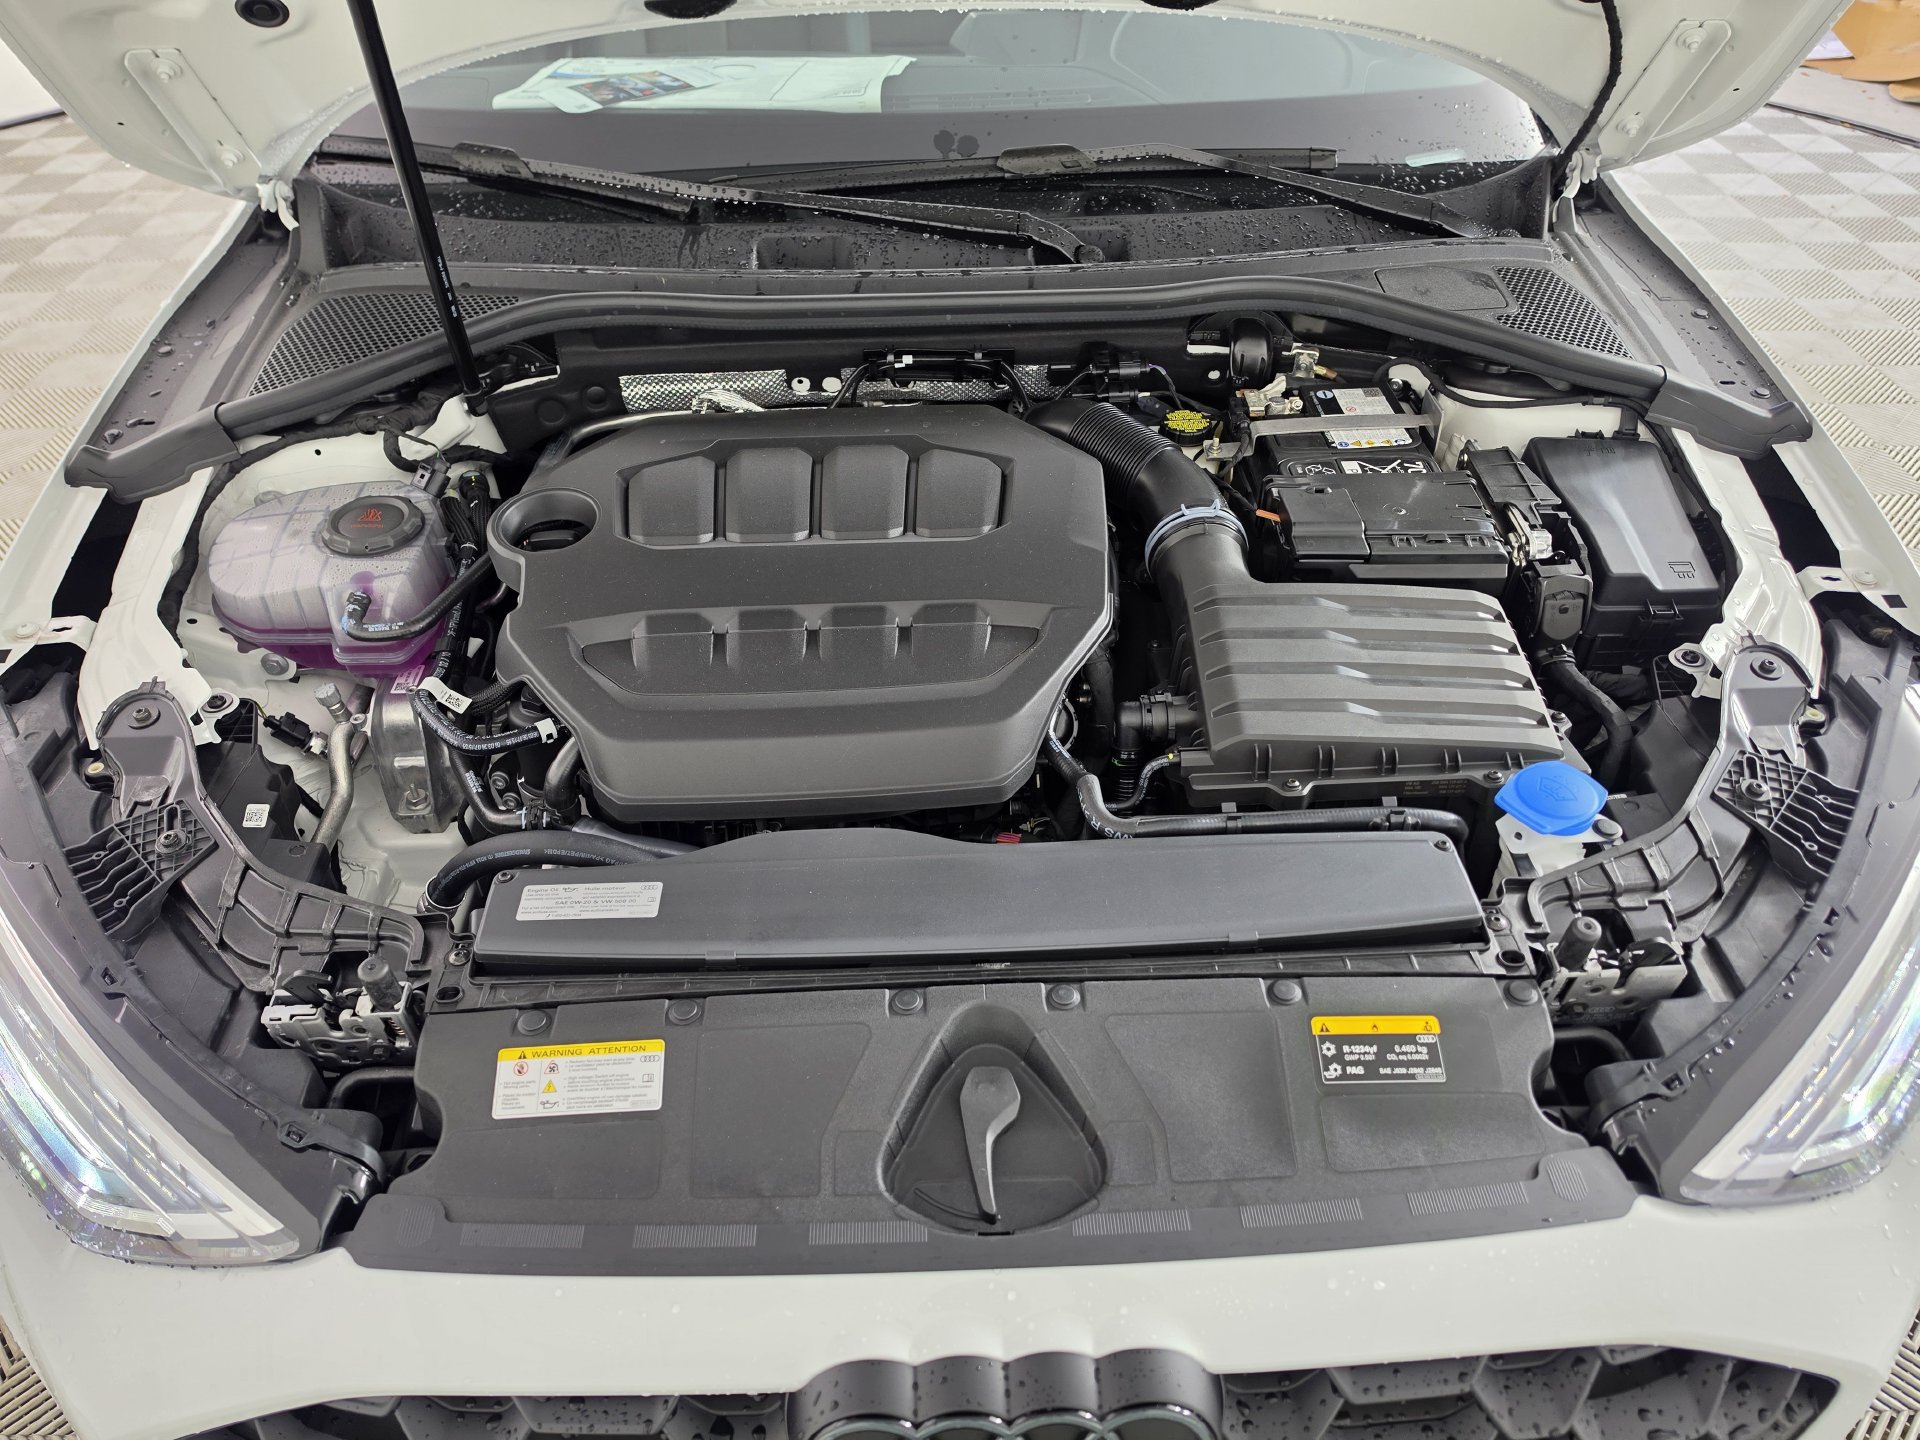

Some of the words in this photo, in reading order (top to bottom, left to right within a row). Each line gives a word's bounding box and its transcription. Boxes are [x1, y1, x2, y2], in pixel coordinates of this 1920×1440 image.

[531, 1048, 583, 1059] WARNING
[589, 1045, 647, 1056] ATTENTION
[1342, 1044, 1377, 1054] R-1234yf
[1416, 1044, 1428, 1054] kg
[1344, 1053, 1359, 1061] GWP
[1346, 1066, 1365, 1074] PAG
